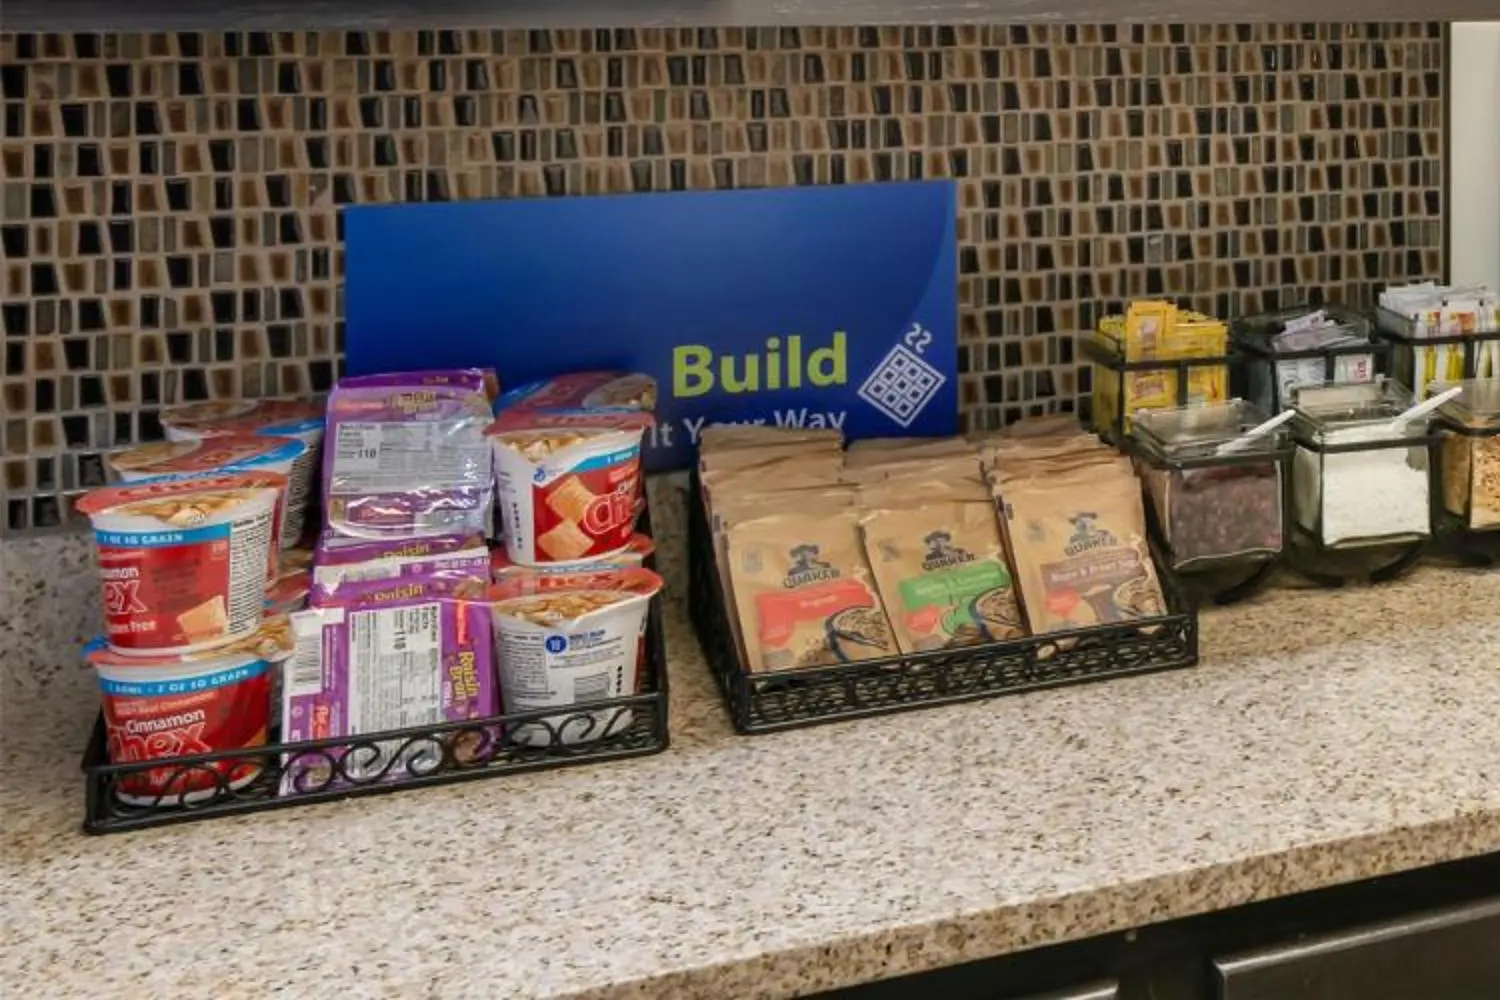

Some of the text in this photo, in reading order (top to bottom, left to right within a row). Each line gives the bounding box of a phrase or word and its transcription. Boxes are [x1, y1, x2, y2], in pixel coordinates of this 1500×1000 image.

[672, 331, 847, 397] Build
[650, 419, 674, 449] It
[772, 407, 848, 430] Way
[211, 669, 249, 686] GRAIN
[448, 665, 467, 701] Bran
[458, 651, 481, 698] Raisin
[108, 721, 213, 763] hex
[126, 709, 206, 734] Cinnamon
